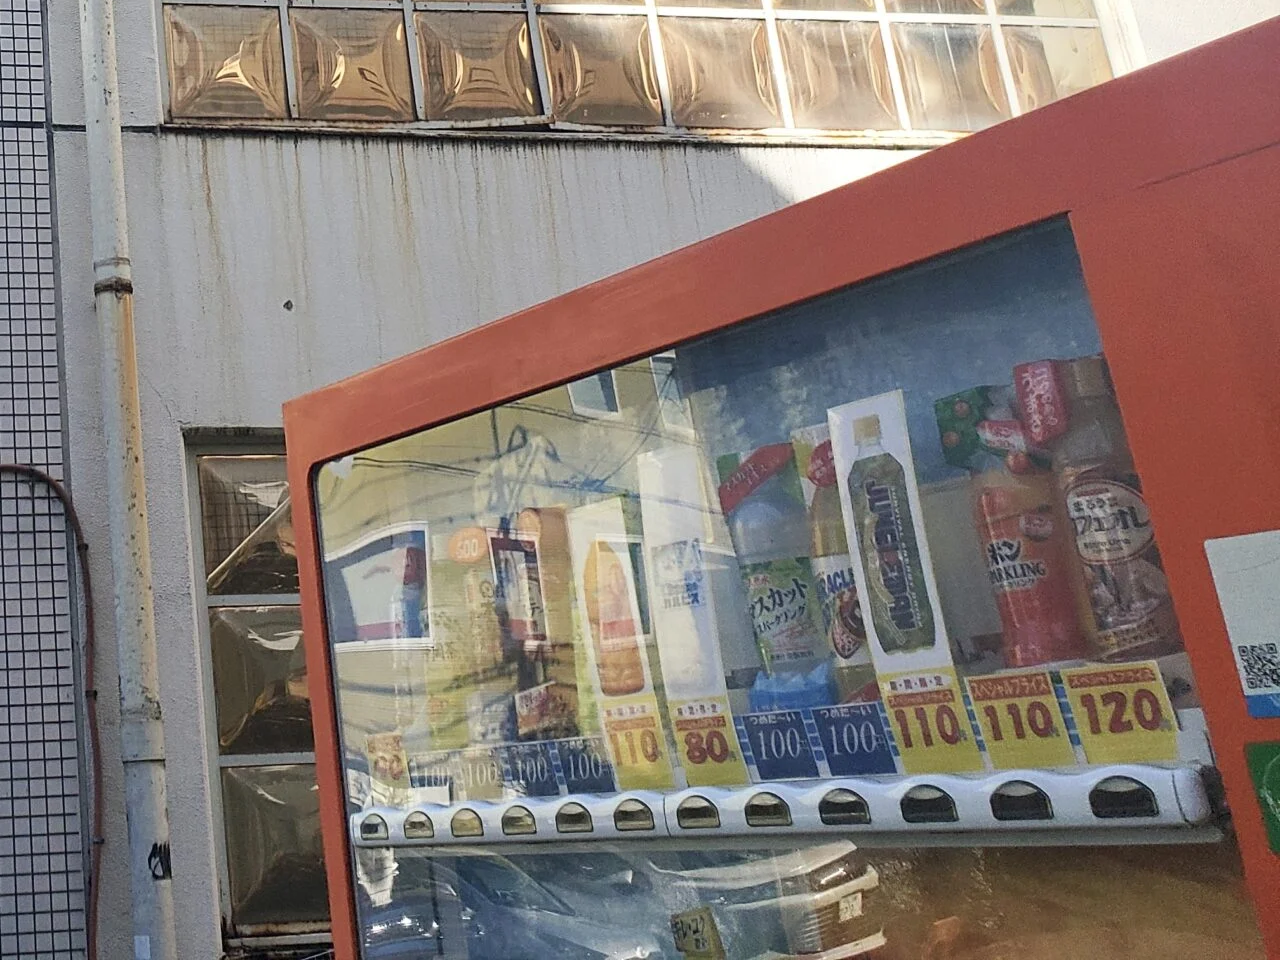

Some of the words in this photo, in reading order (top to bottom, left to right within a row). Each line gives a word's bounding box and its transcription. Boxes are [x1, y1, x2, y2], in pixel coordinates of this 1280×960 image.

[895, 704, 960, 748] 110
[984, 701, 1053, 741] 110
[1081, 690, 1163, 735] 120
[685, 730, 729, 764] 80
[757, 727, 802, 760] 100
[830, 720, 877, 756] 100
